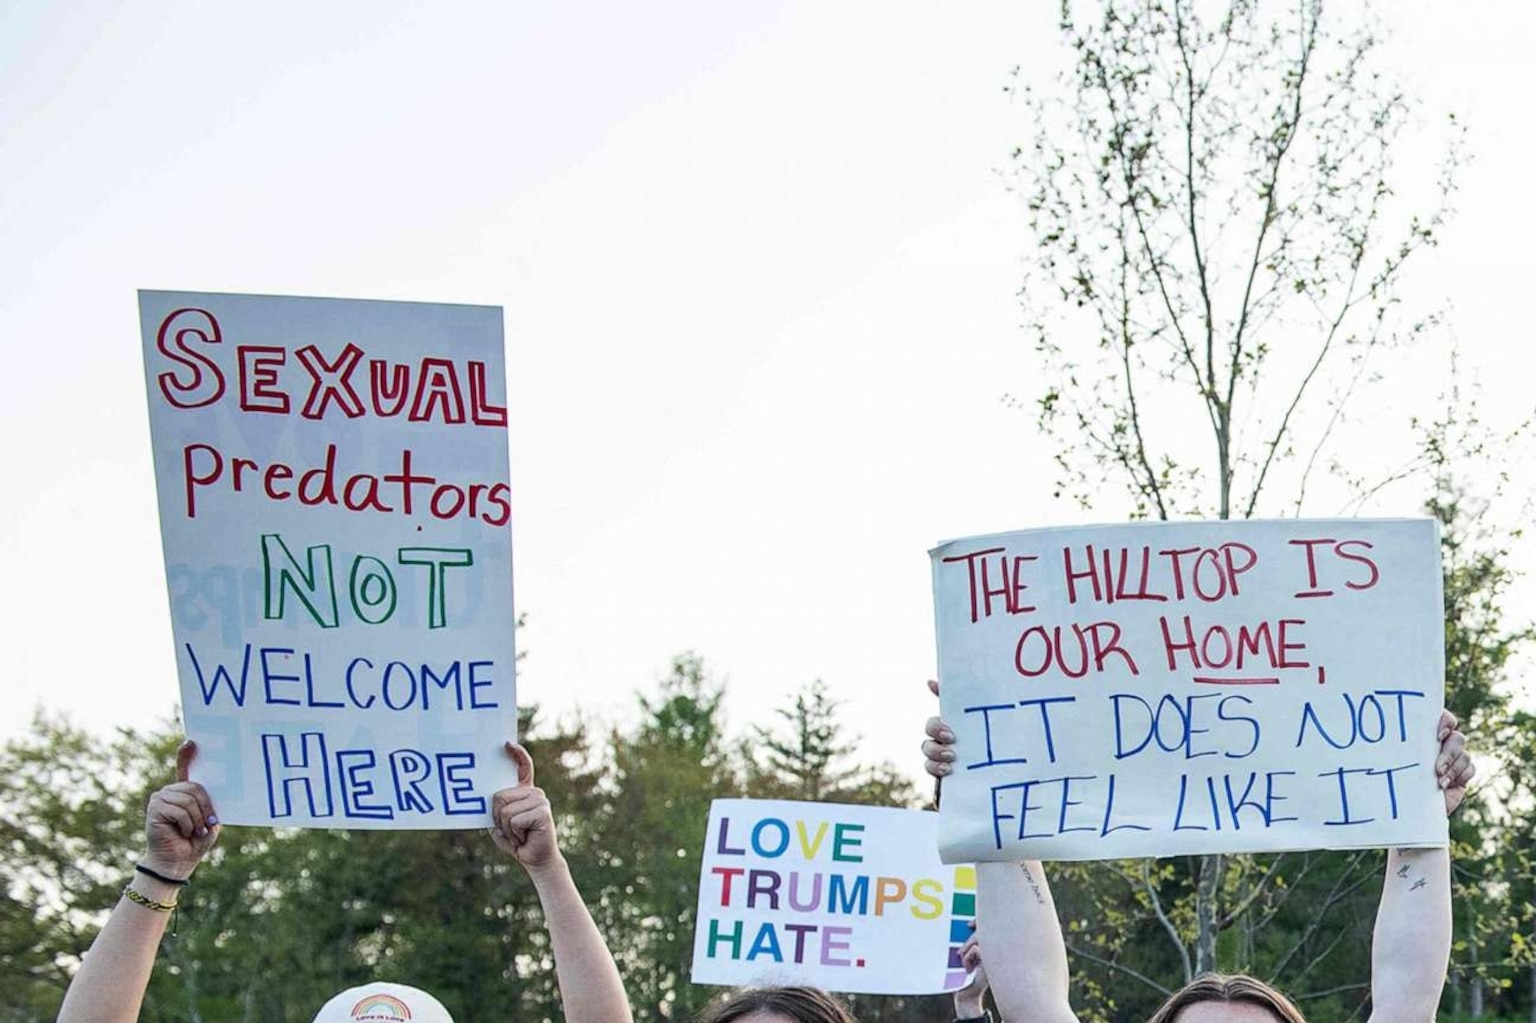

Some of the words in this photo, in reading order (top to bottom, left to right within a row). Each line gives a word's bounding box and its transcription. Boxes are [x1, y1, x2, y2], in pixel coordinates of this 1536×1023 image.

[157, 308, 508, 426] SEXUAL
[261, 534, 473, 628] NOT
[942, 546, 1039, 622] THE
[1065, 541, 1258, 606] HILLTOP
[1288, 538, 1381, 598] IS
[186, 643, 499, 711] WELCOME
[1014, 620, 1139, 679] OUR
[1160, 616, 1327, 685] HOME,
[965, 696, 1077, 770] IT
[1111, 692, 1261, 760] DOES
[1296, 690, 1427, 749] NOT
[261, 732, 487, 820] HERE
[990, 774, 1152, 850] FEEL
[1173, 770, 1299, 833] LIKE
[1318, 762, 1421, 827] IT
[716, 816, 865, 864] LOVE
[711, 865, 944, 922] TRUMPS
[707, 920, 866, 968] HATE.
